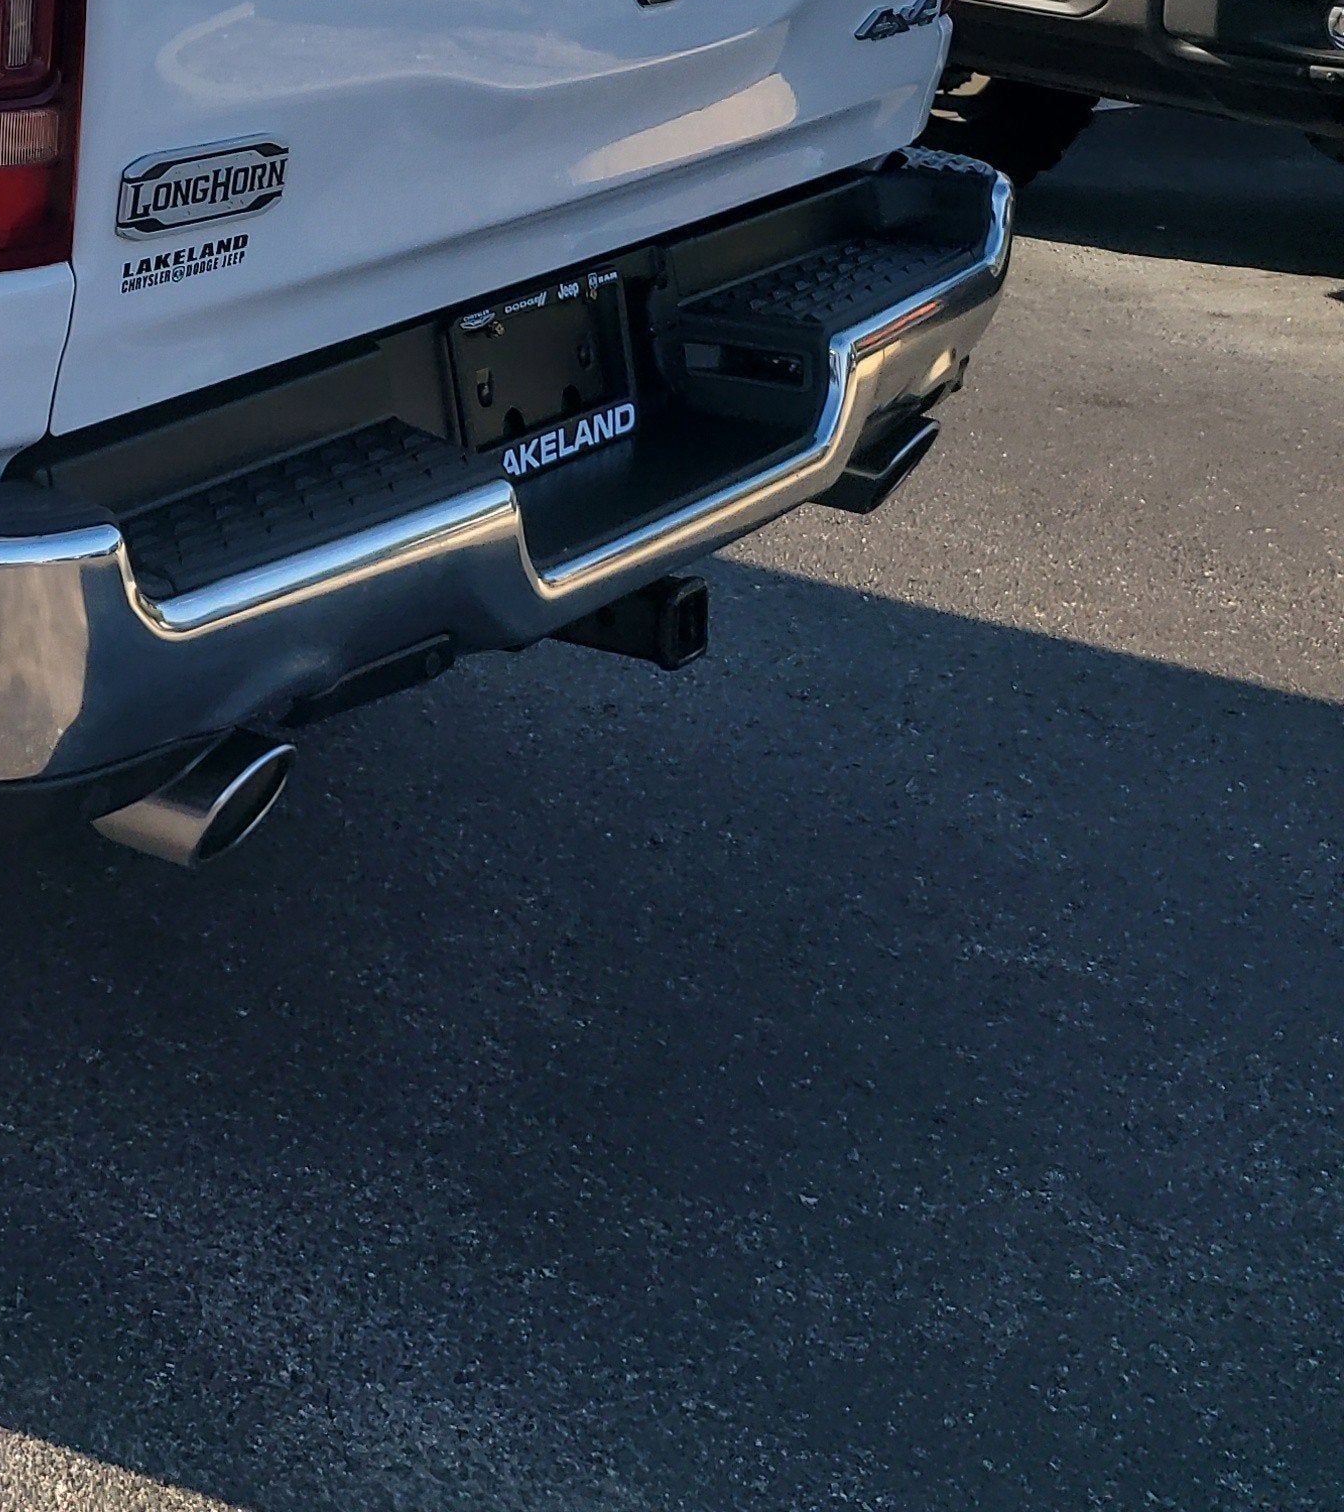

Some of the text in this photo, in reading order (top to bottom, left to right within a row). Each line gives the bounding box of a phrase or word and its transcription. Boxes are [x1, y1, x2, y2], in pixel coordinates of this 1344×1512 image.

[120, 250, 246, 294] CHRYSLER DODGE JEEP
[122, 233, 249, 279] LAKELAND
[557, 282, 580, 300] Jeep
[598, 271, 618, 284] RAM
[502, 402, 636, 477] AKELAND
